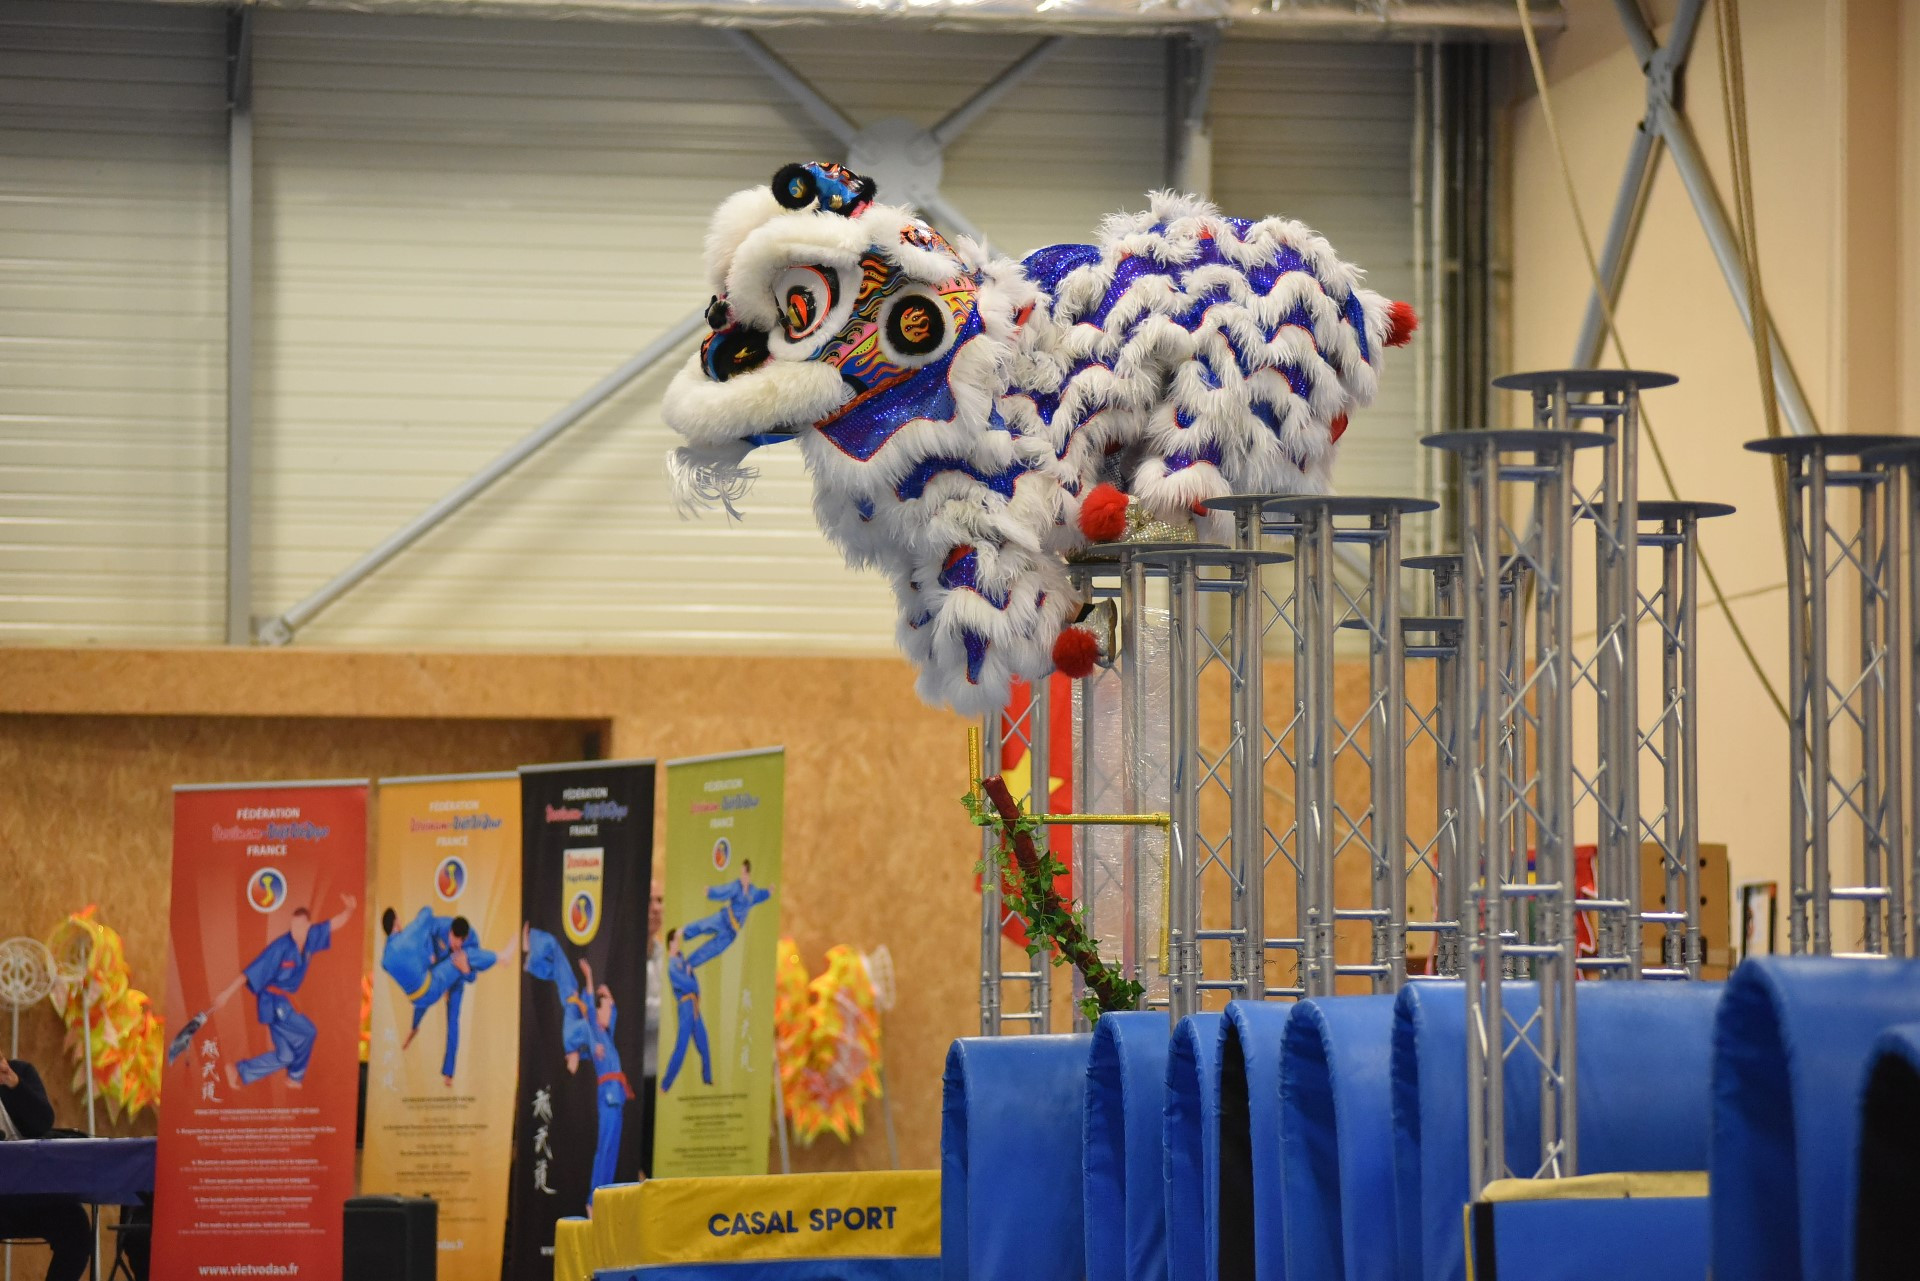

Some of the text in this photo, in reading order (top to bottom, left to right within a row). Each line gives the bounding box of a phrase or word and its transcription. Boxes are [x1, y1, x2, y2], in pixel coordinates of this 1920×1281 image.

[236, 807, 300, 820] FÉDÉRATION
[246, 844, 288, 857] FRANCE
[708, 1206, 897, 1236] CASAL SPORT
[198, 1262, 299, 1277] www.vietvodao.fr
